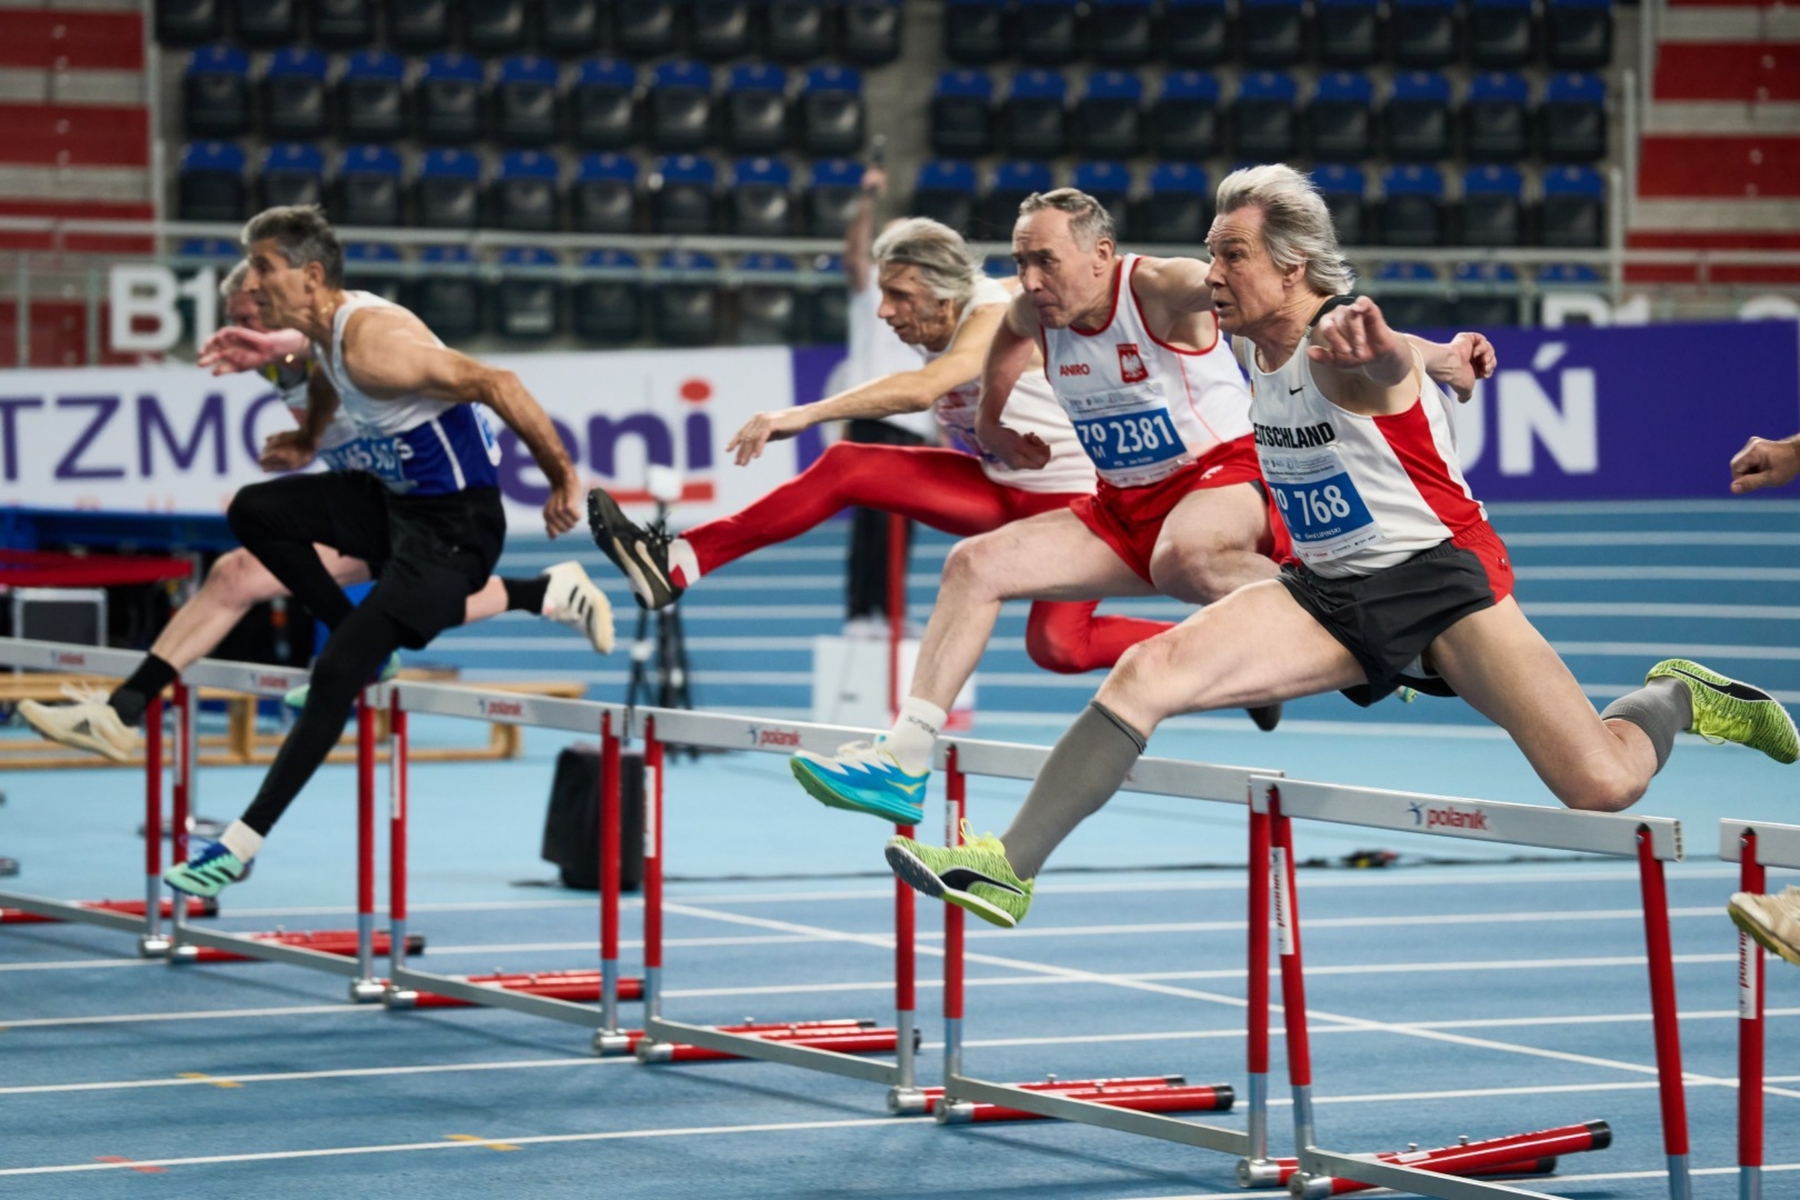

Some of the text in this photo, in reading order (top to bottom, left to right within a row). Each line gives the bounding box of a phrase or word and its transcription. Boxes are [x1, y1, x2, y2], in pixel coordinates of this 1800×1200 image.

[110, 266, 216, 352] B1
[1060, 363, 1091, 376] ANIRO
[1077, 415, 1174, 454] 70 2381
[1293, 484, 1350, 526] 768
[760, 727, 802, 747] polanik
[1426, 806, 1488, 830] polanik
